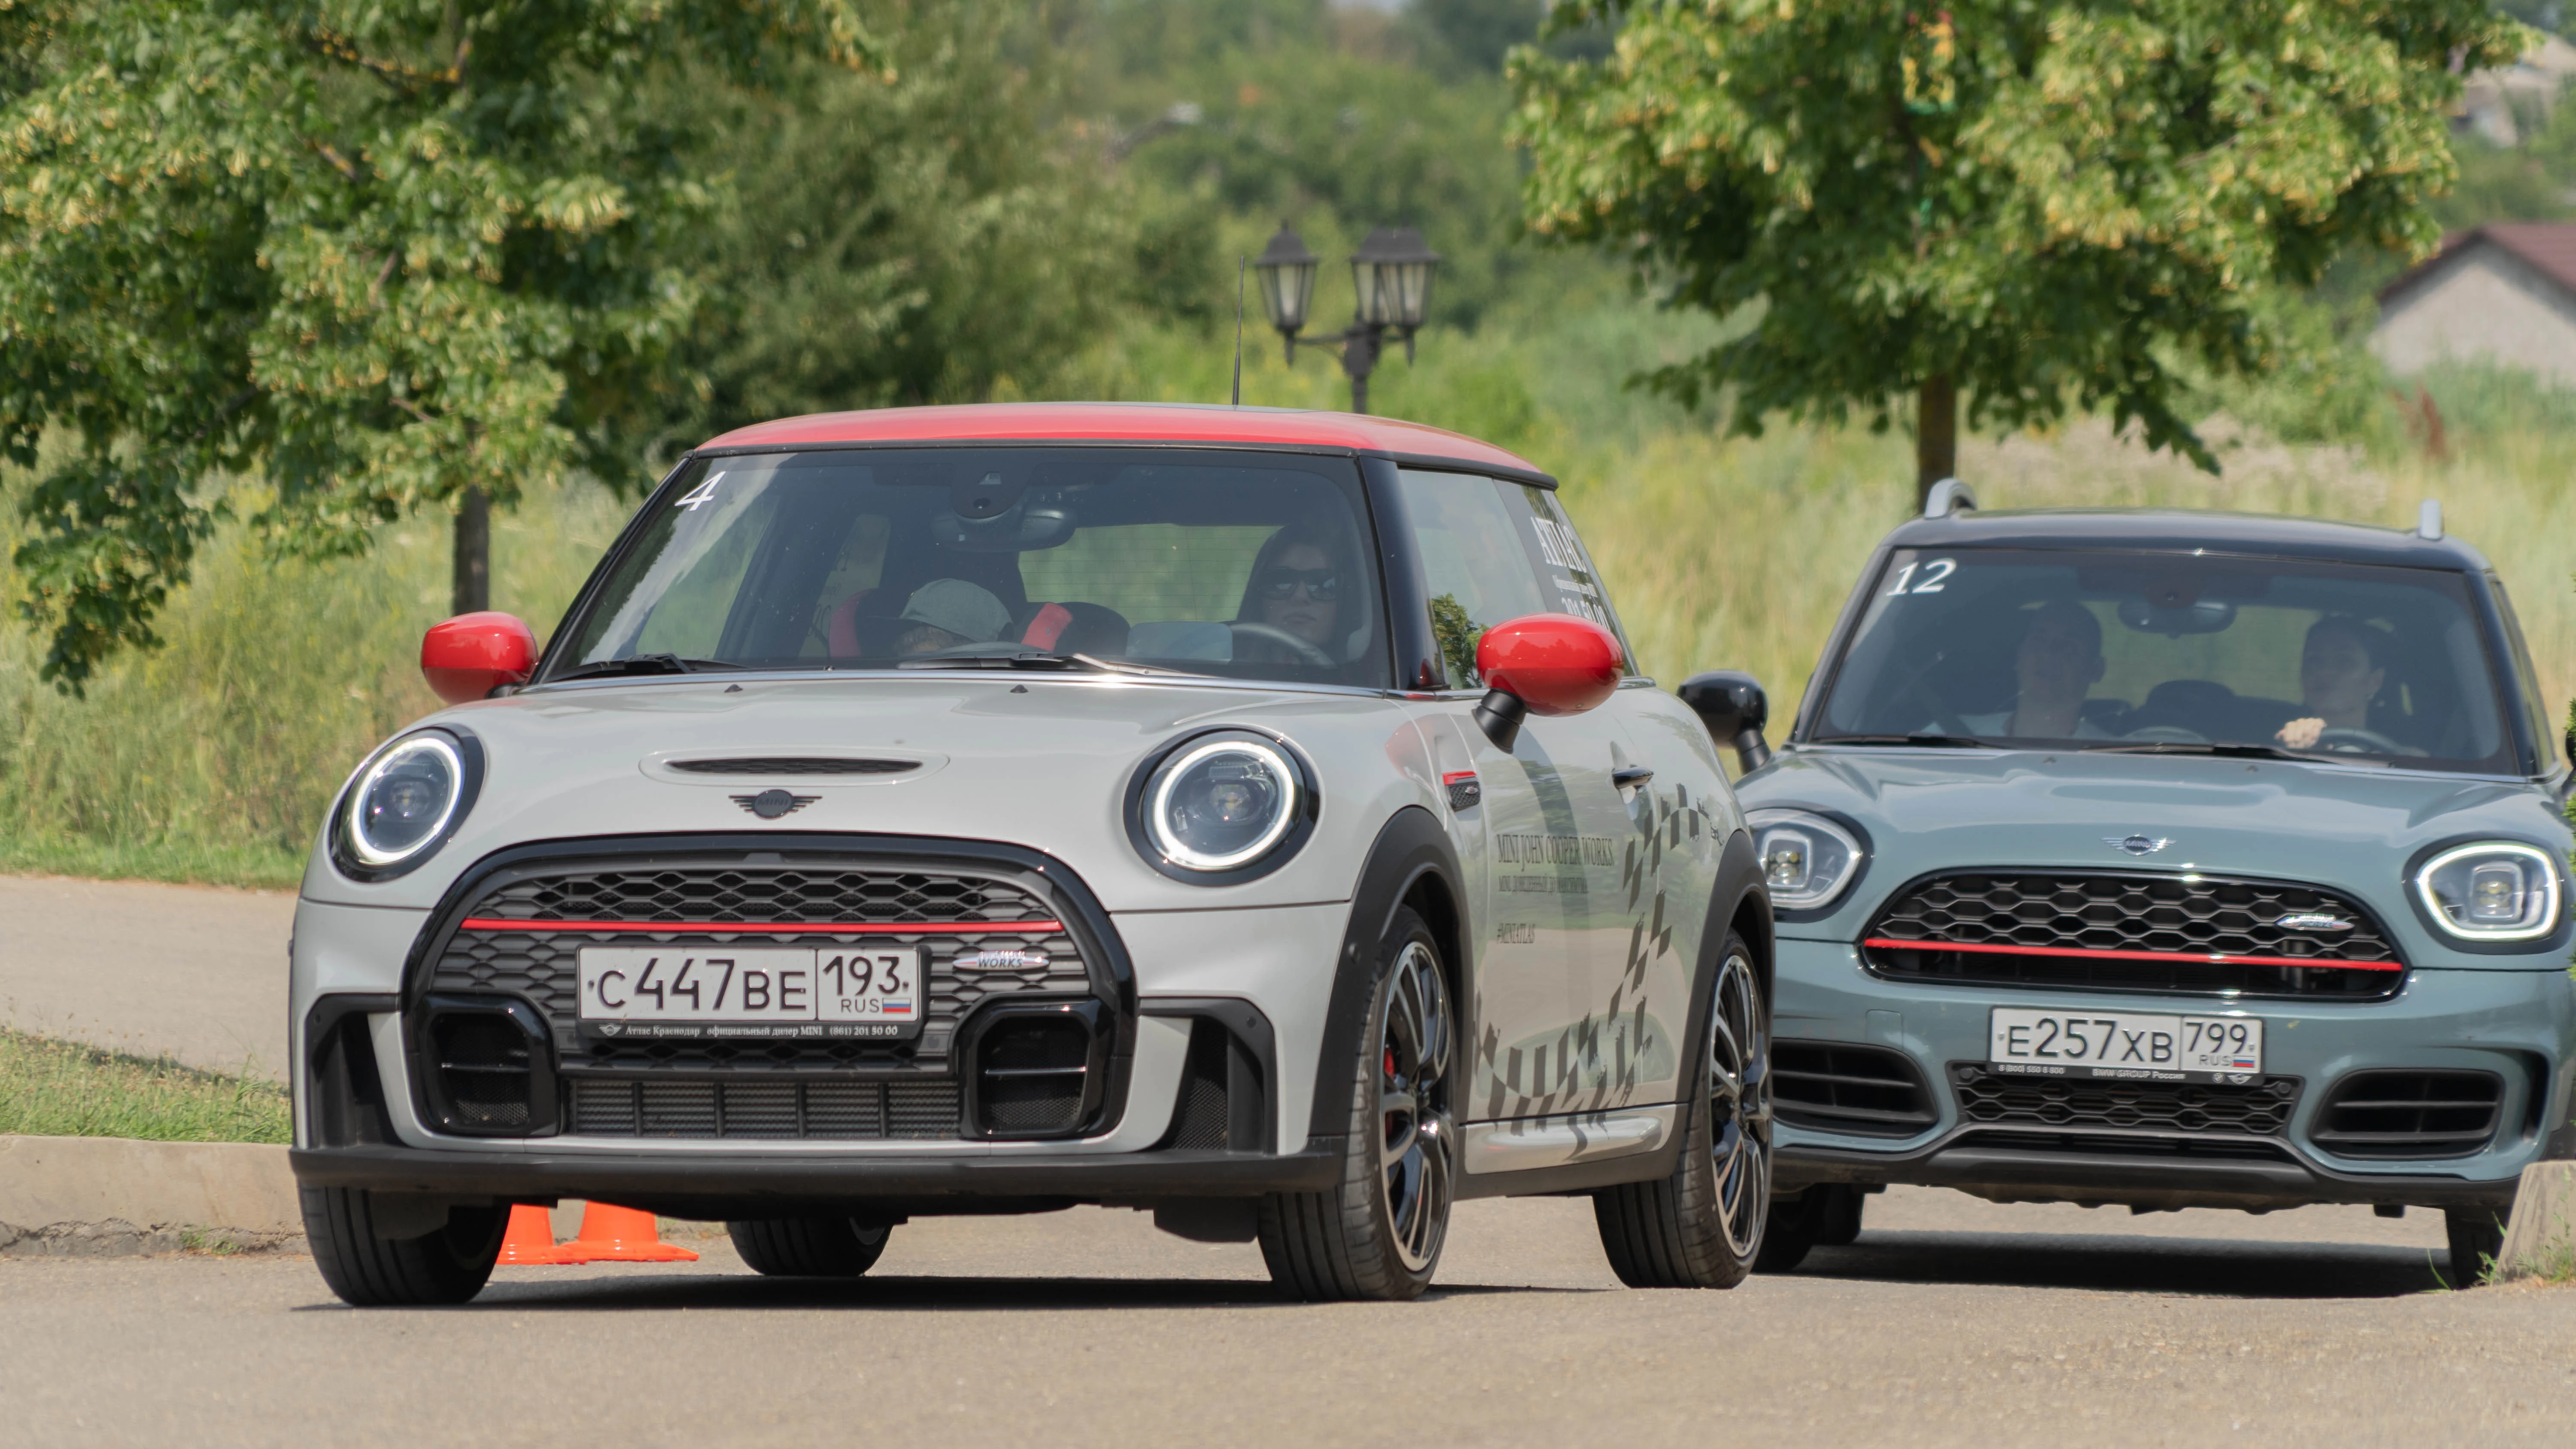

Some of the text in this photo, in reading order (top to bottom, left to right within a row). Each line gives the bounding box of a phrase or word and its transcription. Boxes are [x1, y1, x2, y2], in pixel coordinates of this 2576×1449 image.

[674, 471, 726, 511] 4
[1886, 558, 1956, 596] 12
[1497, 834, 1520, 863] MINI
[1520, 835, 1544, 872] JOHN
[1546, 835, 1582, 865] COOPER
[978, 959, 1022, 967] WORKS
[822, 956, 901, 996] 193
[840, 998, 880, 1013] RUS
[626, 1024, 651, 1036] Атлас
[653, 1025, 701, 1038] Краснодар
[707, 1024, 770, 1038] официальный
[772, 1026, 799, 1037] дилер
[800, 1025, 823, 1036] MINI
[854, 1025, 869, 1036] 201
[885, 1025, 898, 1036] 00
[2186, 1022, 2248, 1054] 799
[2199, 1054, 2232, 1066] RUS
[2092, 1068, 2115, 1077] BMW
[2116, 1069, 2151, 1078] GROUP
